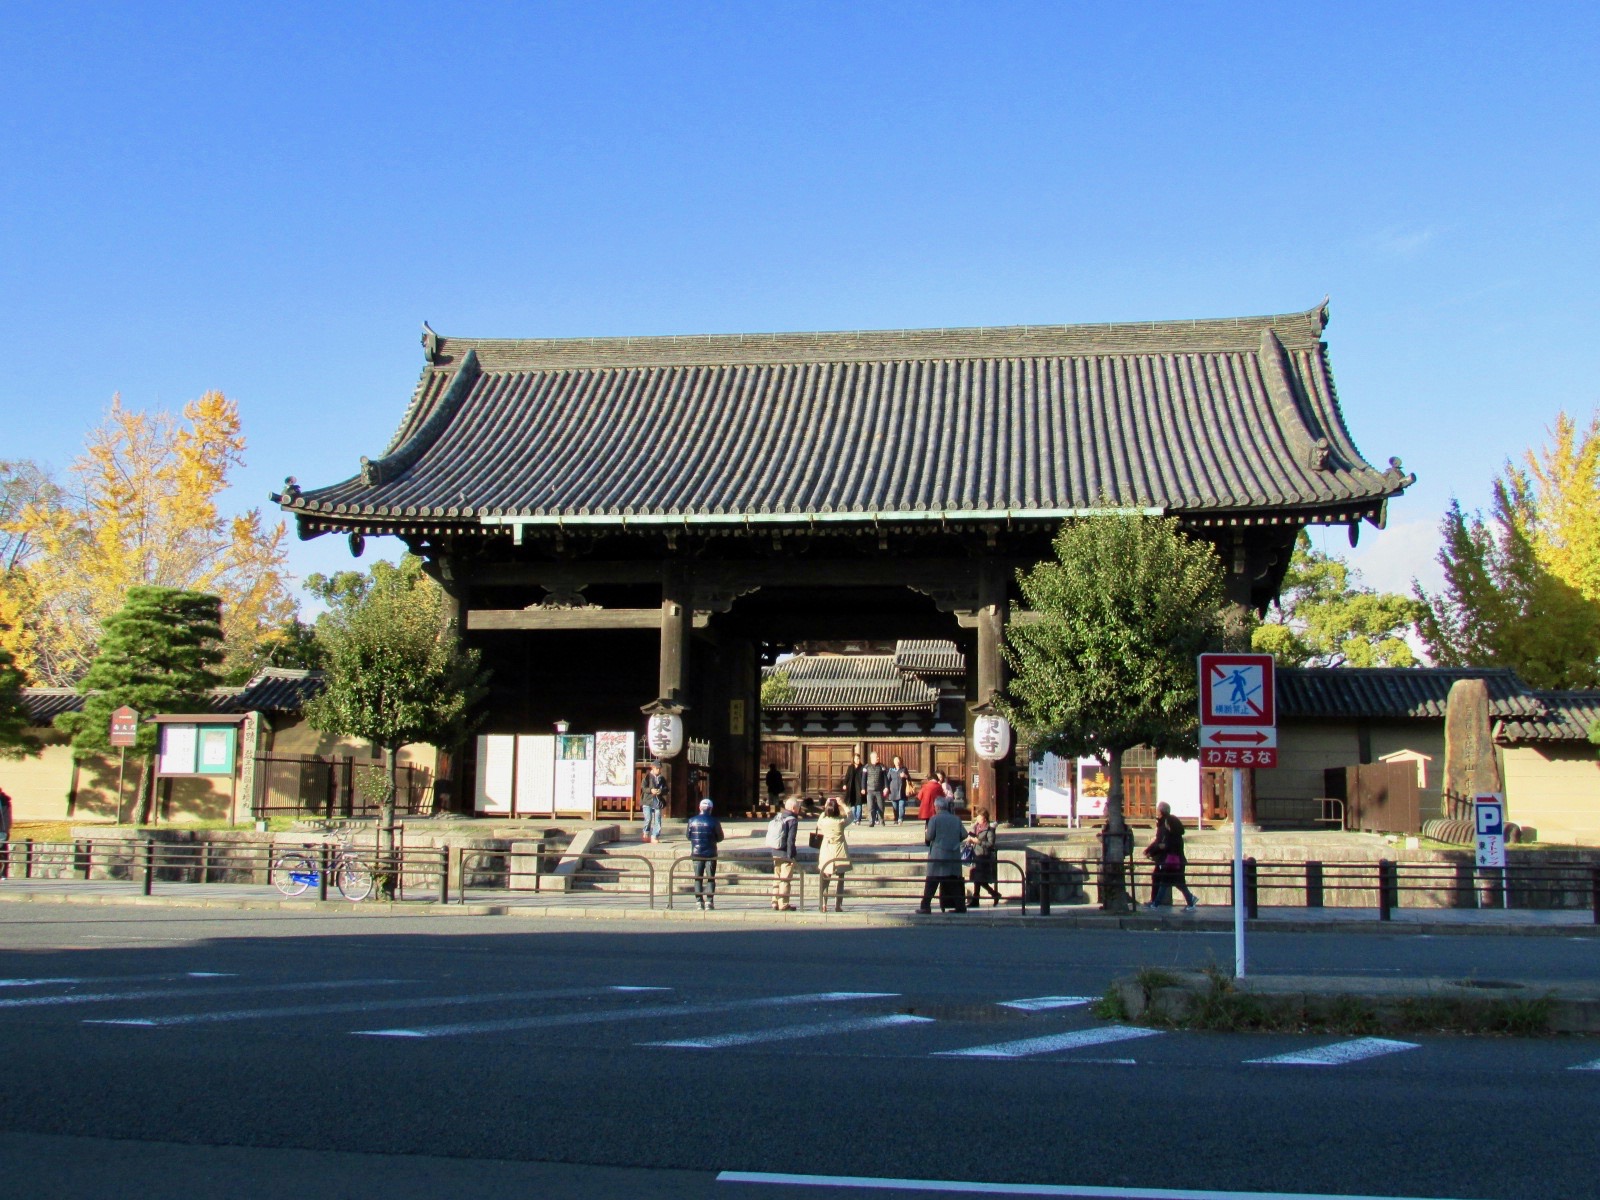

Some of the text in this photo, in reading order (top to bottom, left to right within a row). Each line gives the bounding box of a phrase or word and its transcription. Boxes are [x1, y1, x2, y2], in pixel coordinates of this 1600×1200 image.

[652, 713, 671, 750] 東寺
[978, 717, 999, 753] 東寺
[1207, 750, 1271, 763] わたるな
[1478, 806, 1500, 832] P
